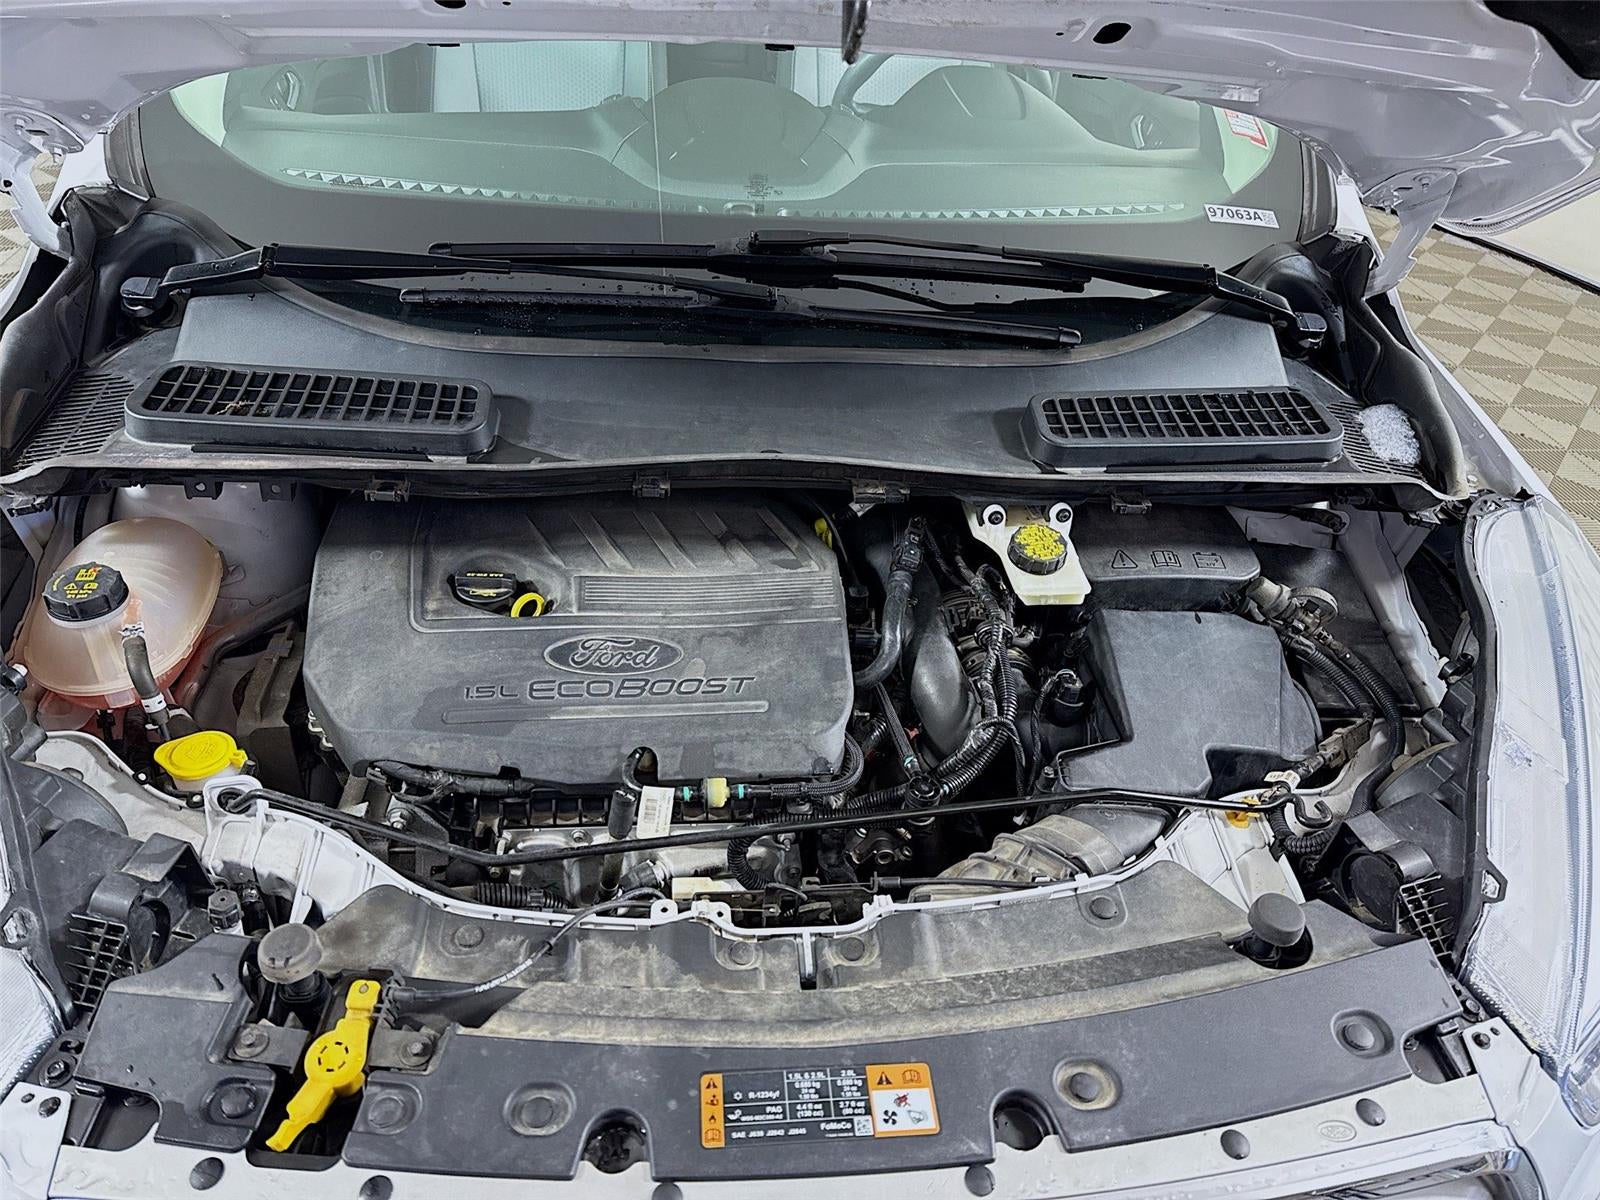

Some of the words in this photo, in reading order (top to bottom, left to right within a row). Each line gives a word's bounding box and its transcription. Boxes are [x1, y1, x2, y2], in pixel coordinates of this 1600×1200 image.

[1207, 206, 1263, 222] 97063A
[570, 637, 658, 669] Ford
[463, 685, 519, 699] 1.5L
[527, 676, 757, 700] ECOBOOST
[765, 1106, 783, 1114] PAG
[820, 1121, 852, 1131] FoMoCo
